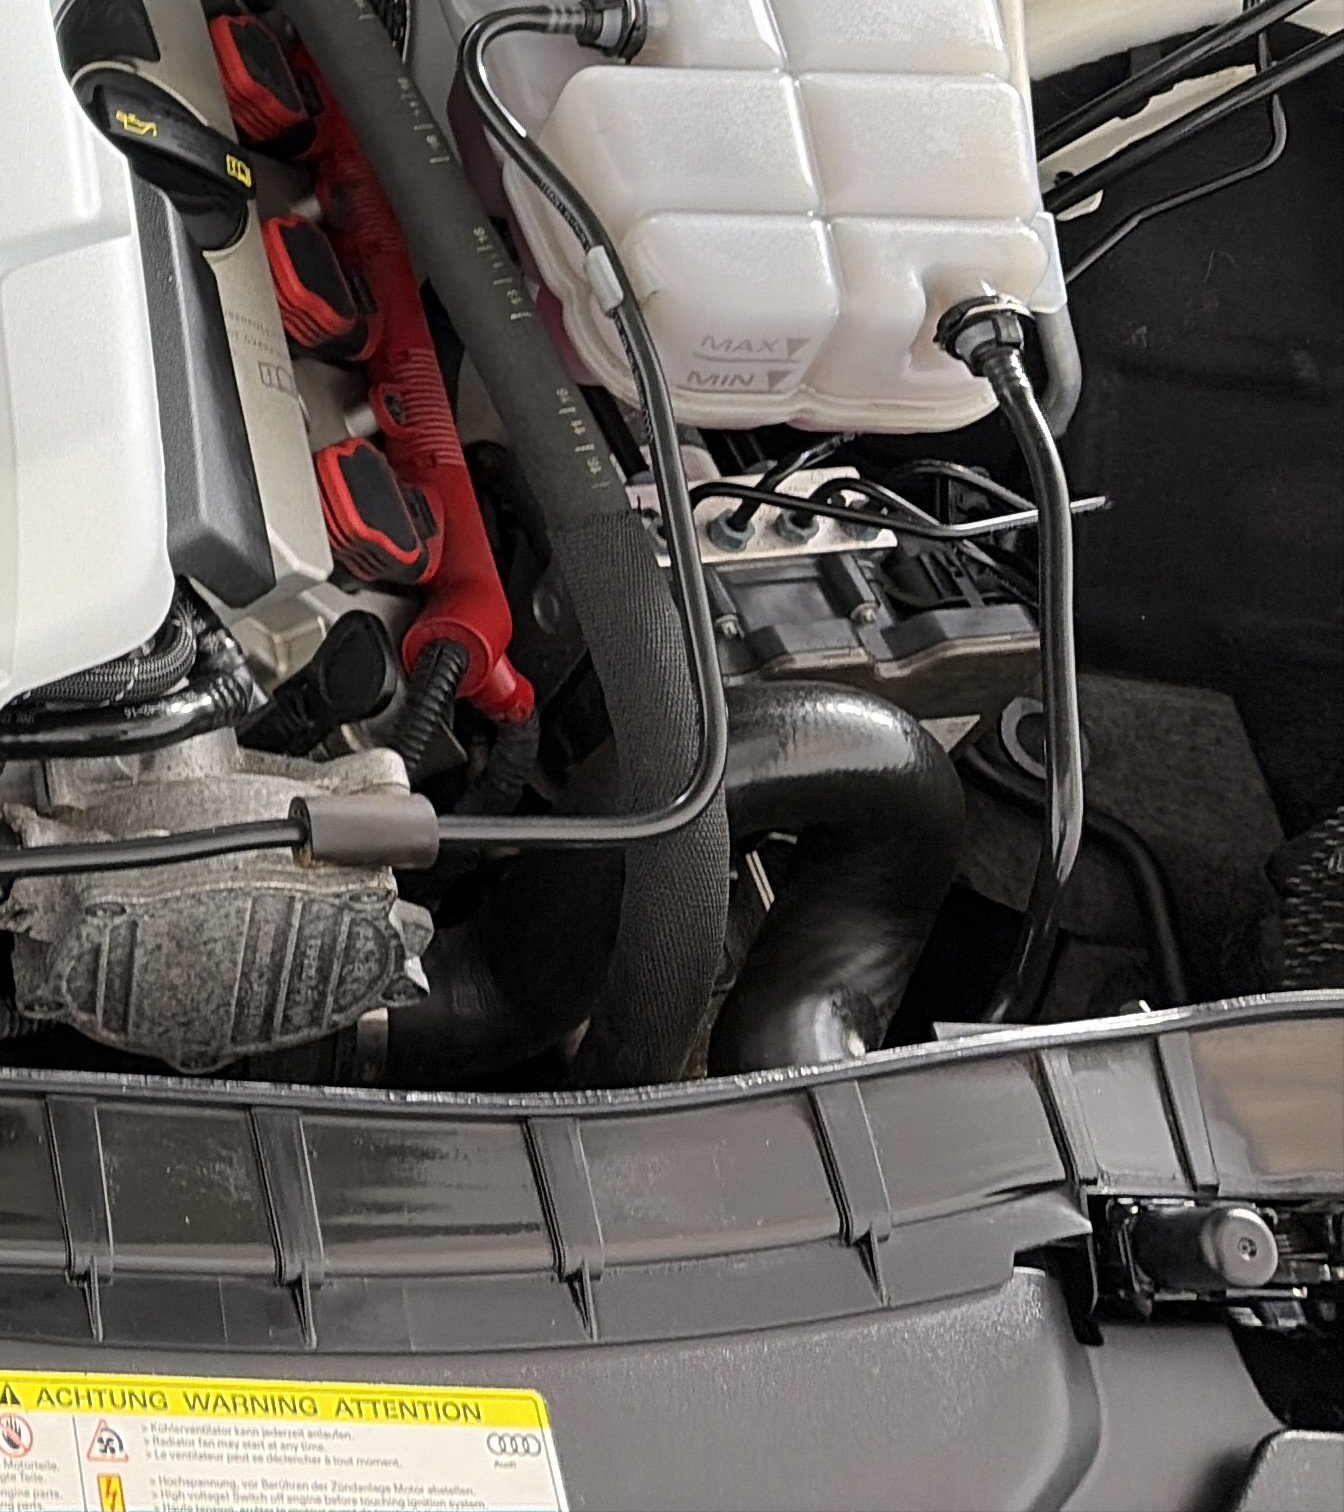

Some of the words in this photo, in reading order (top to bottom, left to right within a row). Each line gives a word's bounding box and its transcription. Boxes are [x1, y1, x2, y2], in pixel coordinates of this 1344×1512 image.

[700, 334, 779, 353] MAX
[686, 369, 754, 386] MIN
[35, 1385, 169, 1411] ACHTUNG
[182, 1390, 319, 1417] WARNING
[334, 1395, 482, 1422] ATTENTION
[197, 1436, 216, 1450] fan
[217, 1439, 240, 1452] may
[242, 1438, 265, 1451] start
